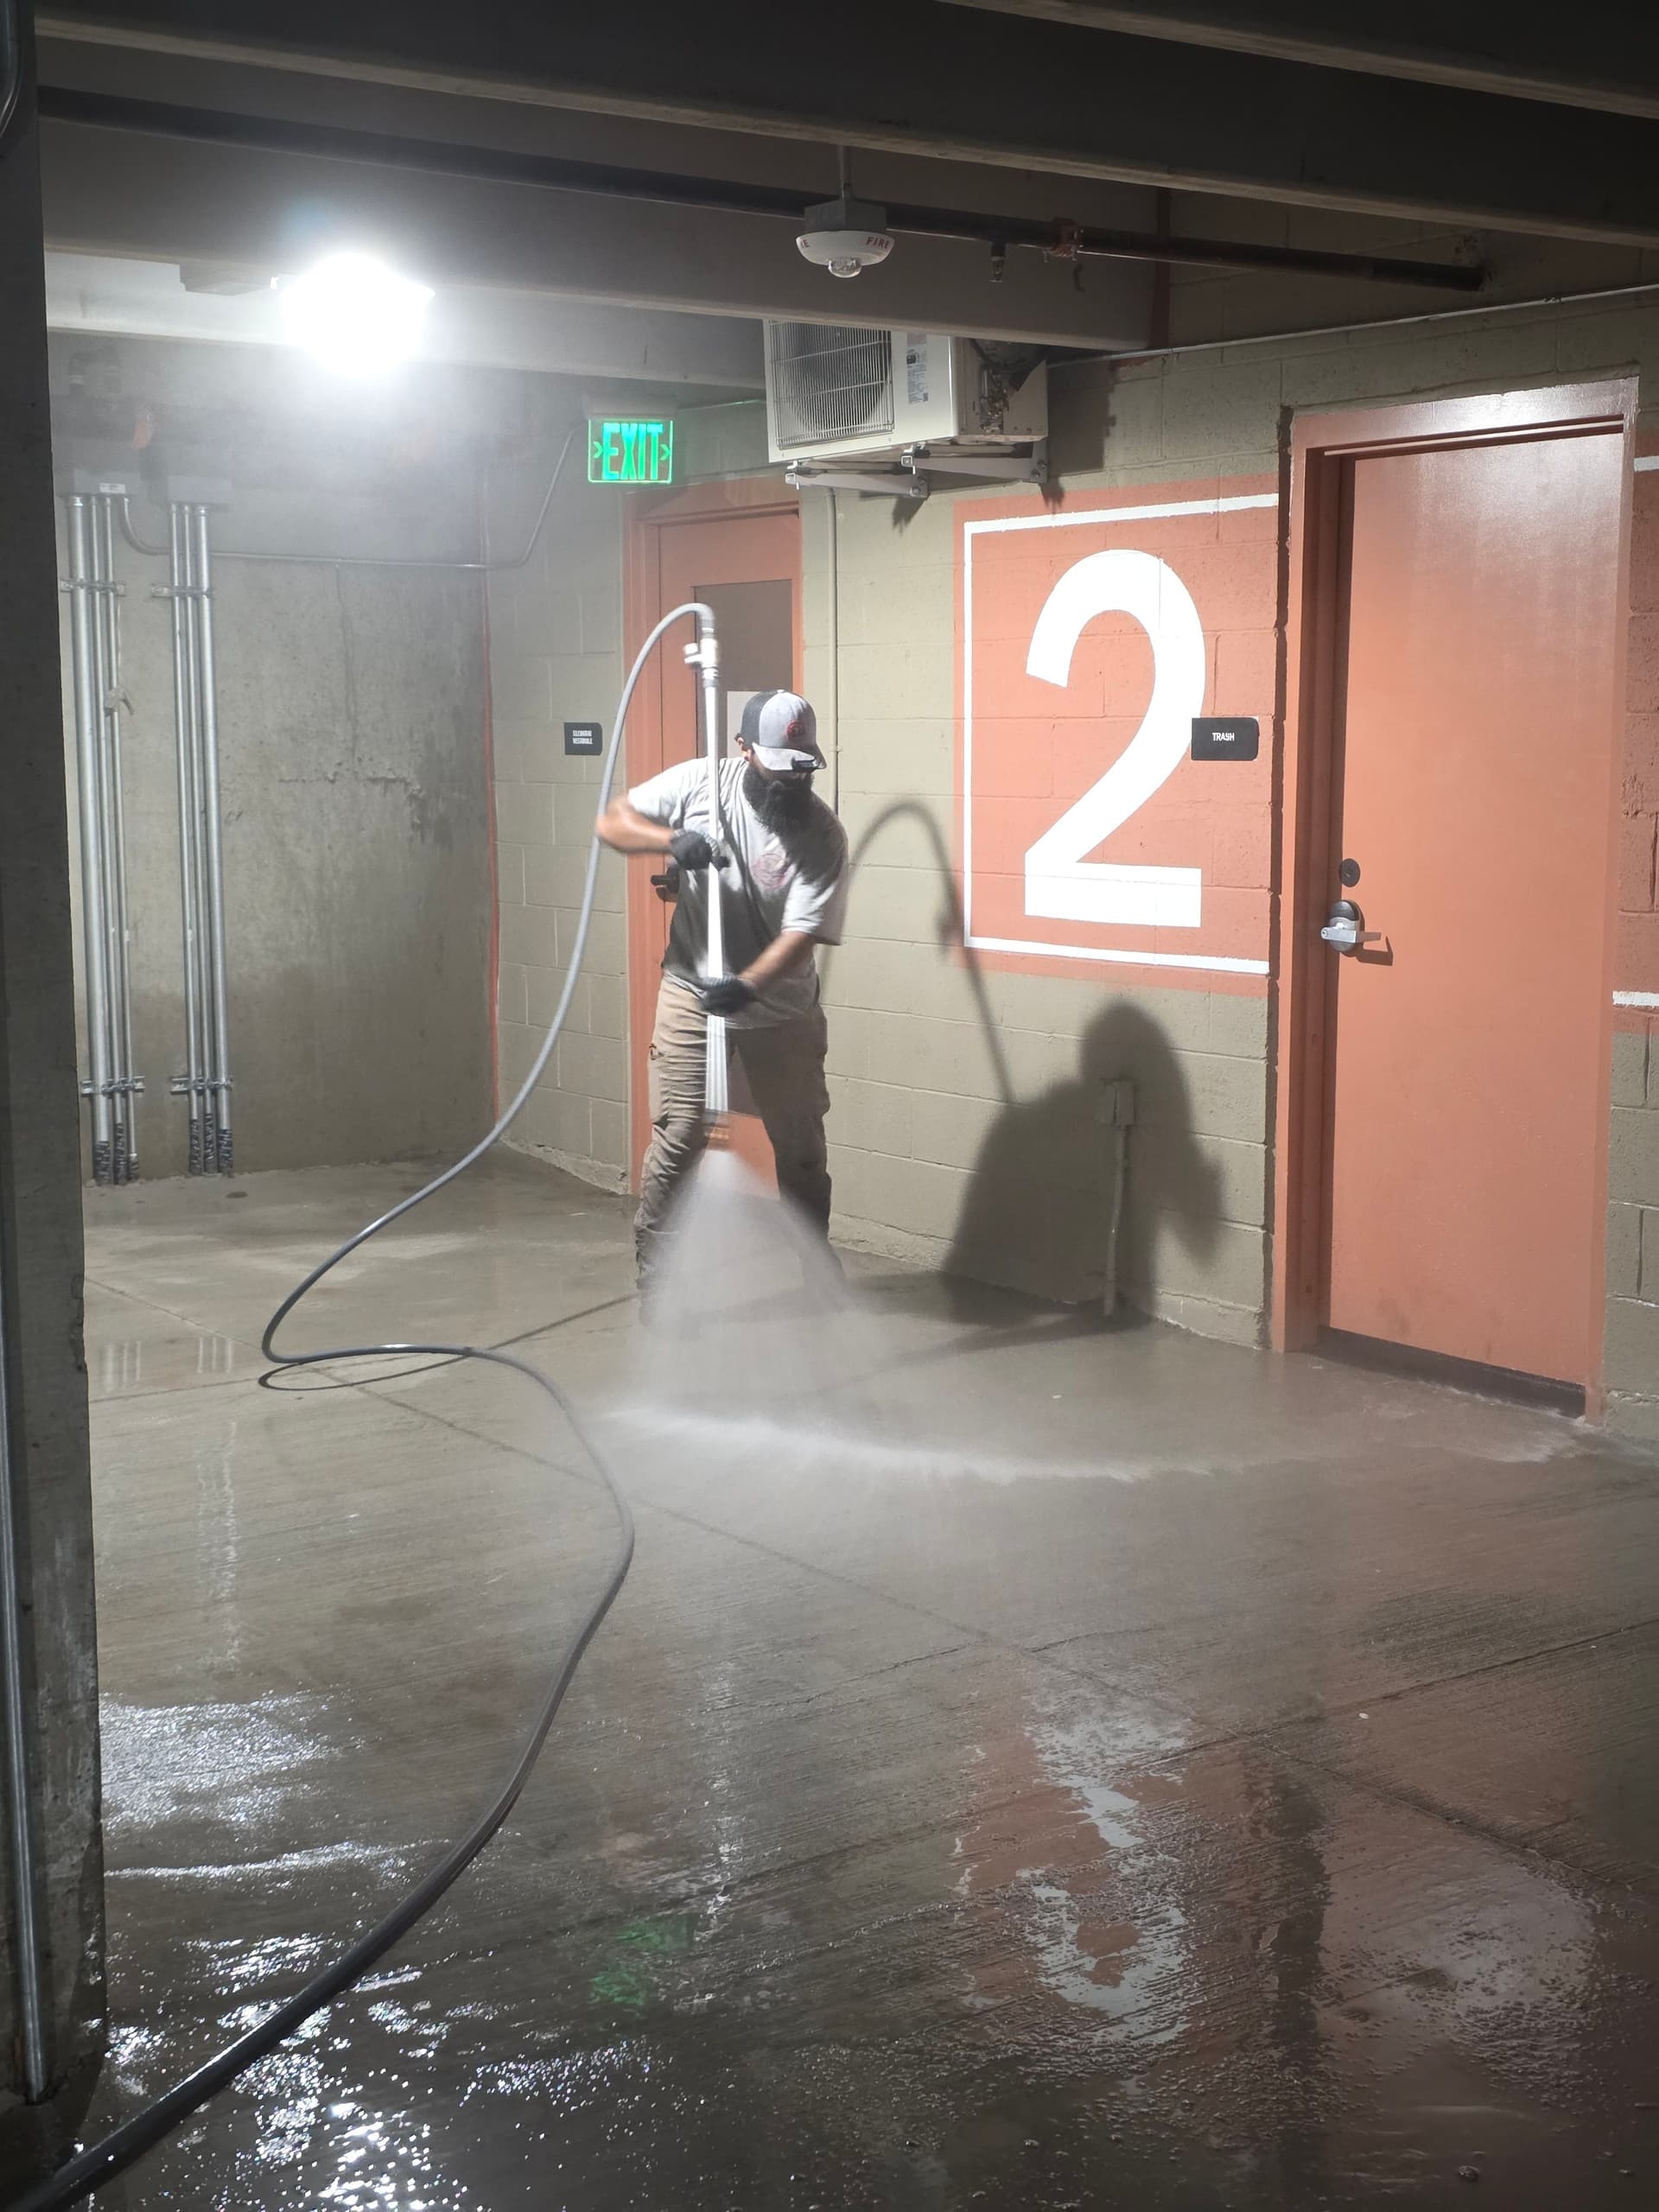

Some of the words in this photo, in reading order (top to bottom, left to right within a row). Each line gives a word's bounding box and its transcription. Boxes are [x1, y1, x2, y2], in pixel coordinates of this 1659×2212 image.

[867, 237, 889, 249] FIRE
[602, 423, 664, 480] EXIT
[1025, 549, 1206, 928] 2
[1212, 733, 1235, 741] TRASH
